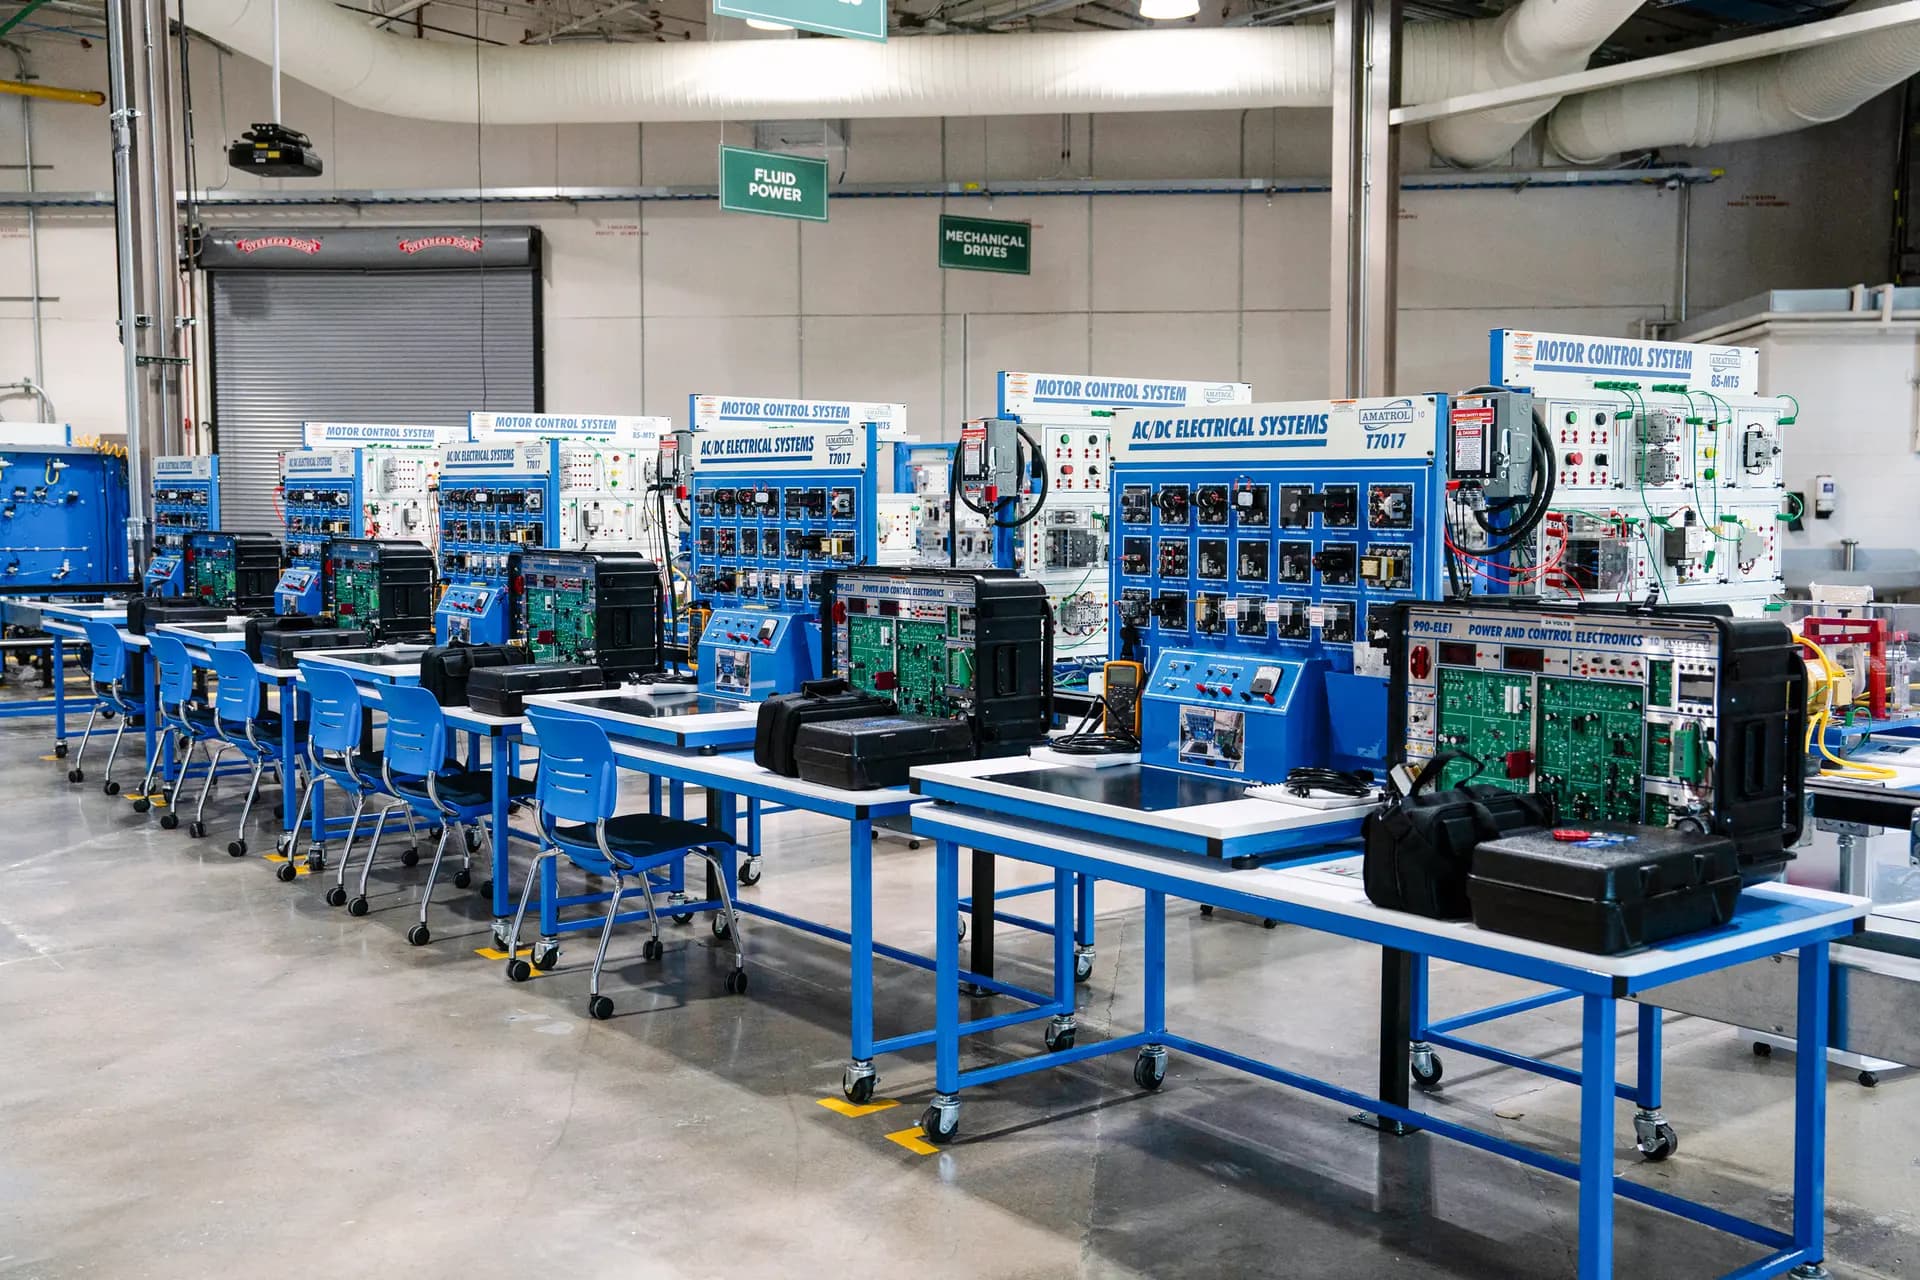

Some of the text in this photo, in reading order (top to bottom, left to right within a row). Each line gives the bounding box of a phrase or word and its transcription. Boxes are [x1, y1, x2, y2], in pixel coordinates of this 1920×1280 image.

[755, 168, 796, 186] FLUID
[749, 182, 802, 202] POWER
[246, 237, 313, 252] OVERHEAD DOOR
[408, 237, 452, 252] OVERHEAD
[946, 230, 1025, 247] MECHANICAL
[964, 244, 1007, 258] DRIVES
[1536, 340, 1585, 363] MOTOR
[1588, 343, 1643, 367] CONTROL
[1647, 348, 1692, 369] SYSTEM
[1711, 375, 1740, 388] 85-MT5
[1035, 379, 1081, 397] MOTOR
[1085, 382, 1139, 400] CONTROL
[1142, 384, 1187, 401] SYSTEM
[721, 401, 759, 416] MOTOR
[763, 403, 809, 417] CONTROL
[812, 405, 850, 418] SYSTEM
[1362, 411, 1411, 422] AMATROL
[495, 416, 617, 430] MOTOR CONTROL SYSTEM
[1132, 414, 1329, 440] AC/DC ELECTRICAL SYSTEMS
[326, 426, 435, 438] MOTOR CONTROL SYSTEM
[701, 435, 814, 455] AC/DC ELECTRICAL SYSTEMS
[1366, 433, 1406, 449] T7017
[461, 450, 490, 461] ELECTRICAL
[491, 449, 514, 460] SYSTEMS
[829, 453, 851, 465] T7017
[862, 585, 878, 593] POWER
[880, 585, 889, 593] AND
[890, 586, 911, 595] CONTROL
[913, 587, 944, 598] ELECTRONICS
[1413, 621, 1452, 633] 990-ELE1
[1468, 624, 1503, 637] POWER
[1504, 627, 1525, 639] AND
[1528, 628, 1573, 643] CONTROL
[1576, 631, 1643, 647] ELECTRONICS
